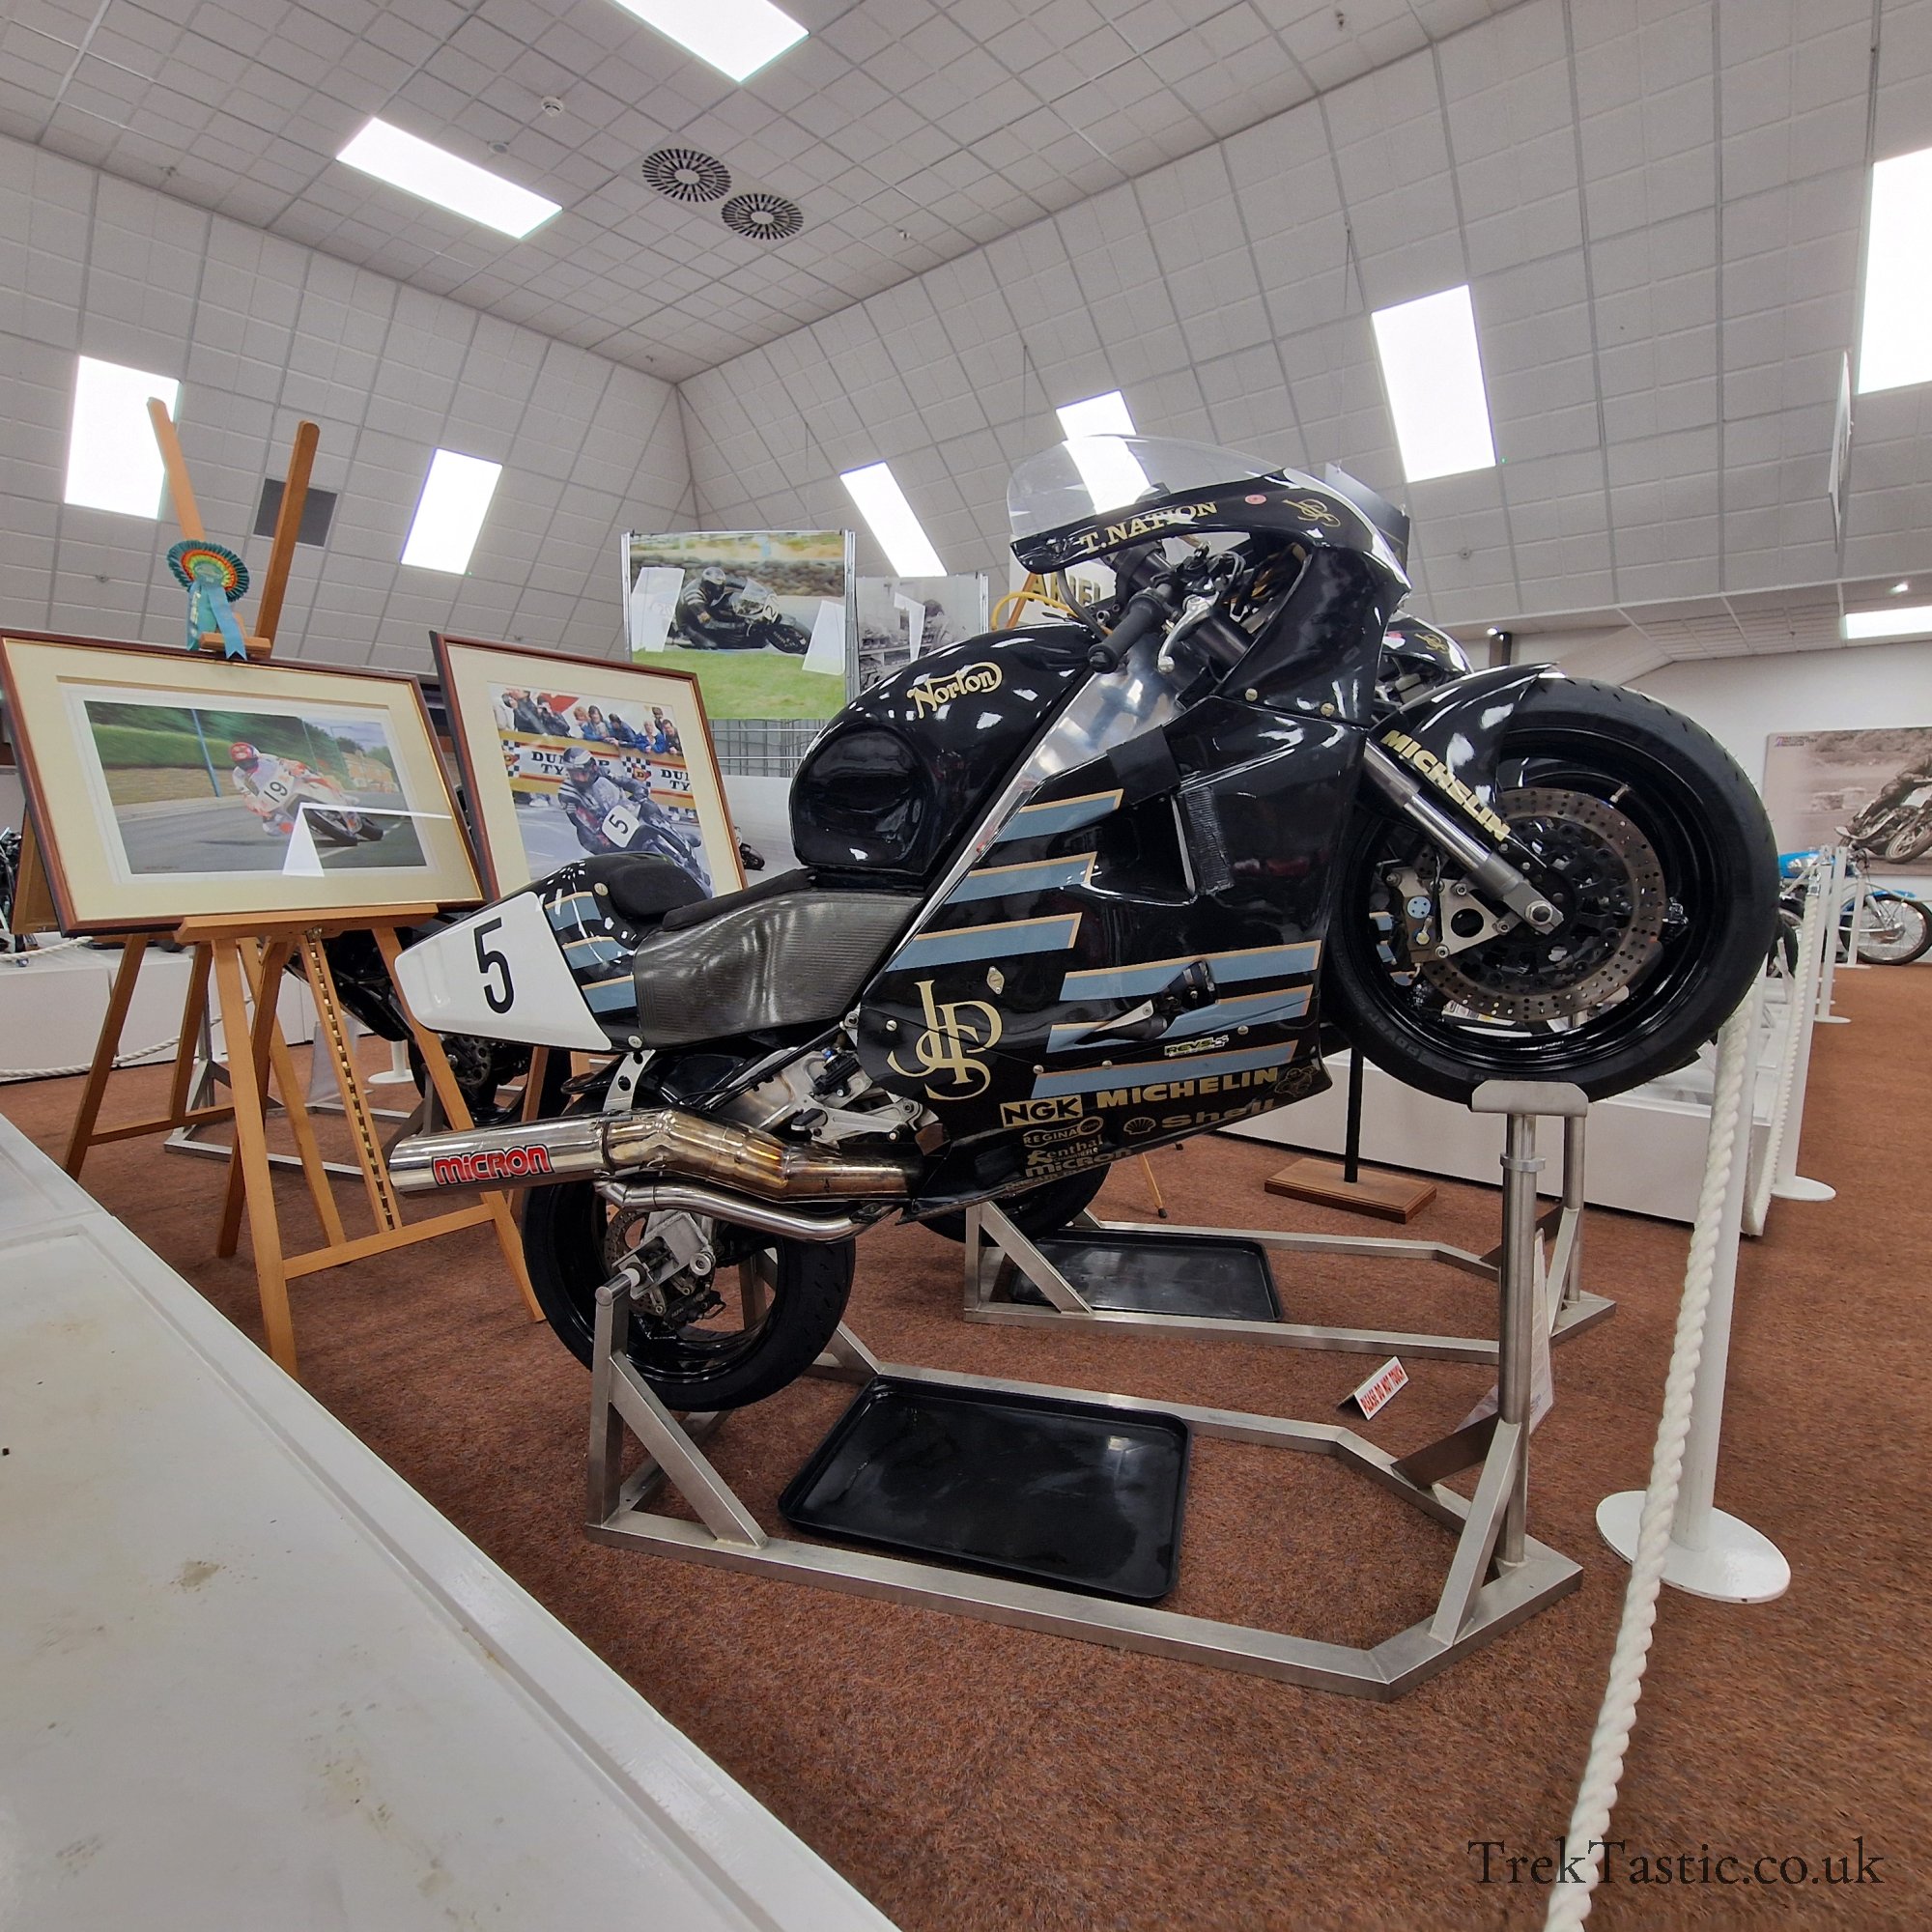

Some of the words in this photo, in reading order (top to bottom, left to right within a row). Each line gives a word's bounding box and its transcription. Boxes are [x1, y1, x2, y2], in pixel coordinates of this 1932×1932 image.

[907, 662, 1003, 719] Norton
[264, 781, 288, 803] 19
[1380, 729, 1511, 841] MICHELIN
[611, 813, 628, 835] 5
[473, 917, 515, 1014] 5
[1096, 1066, 1278, 1109] MICHELIN
[1003, 1097, 1081, 1126] NGK
[1161, 1098, 1275, 1128] Shell
[1023, 1128, 1079, 1144] REGINA
